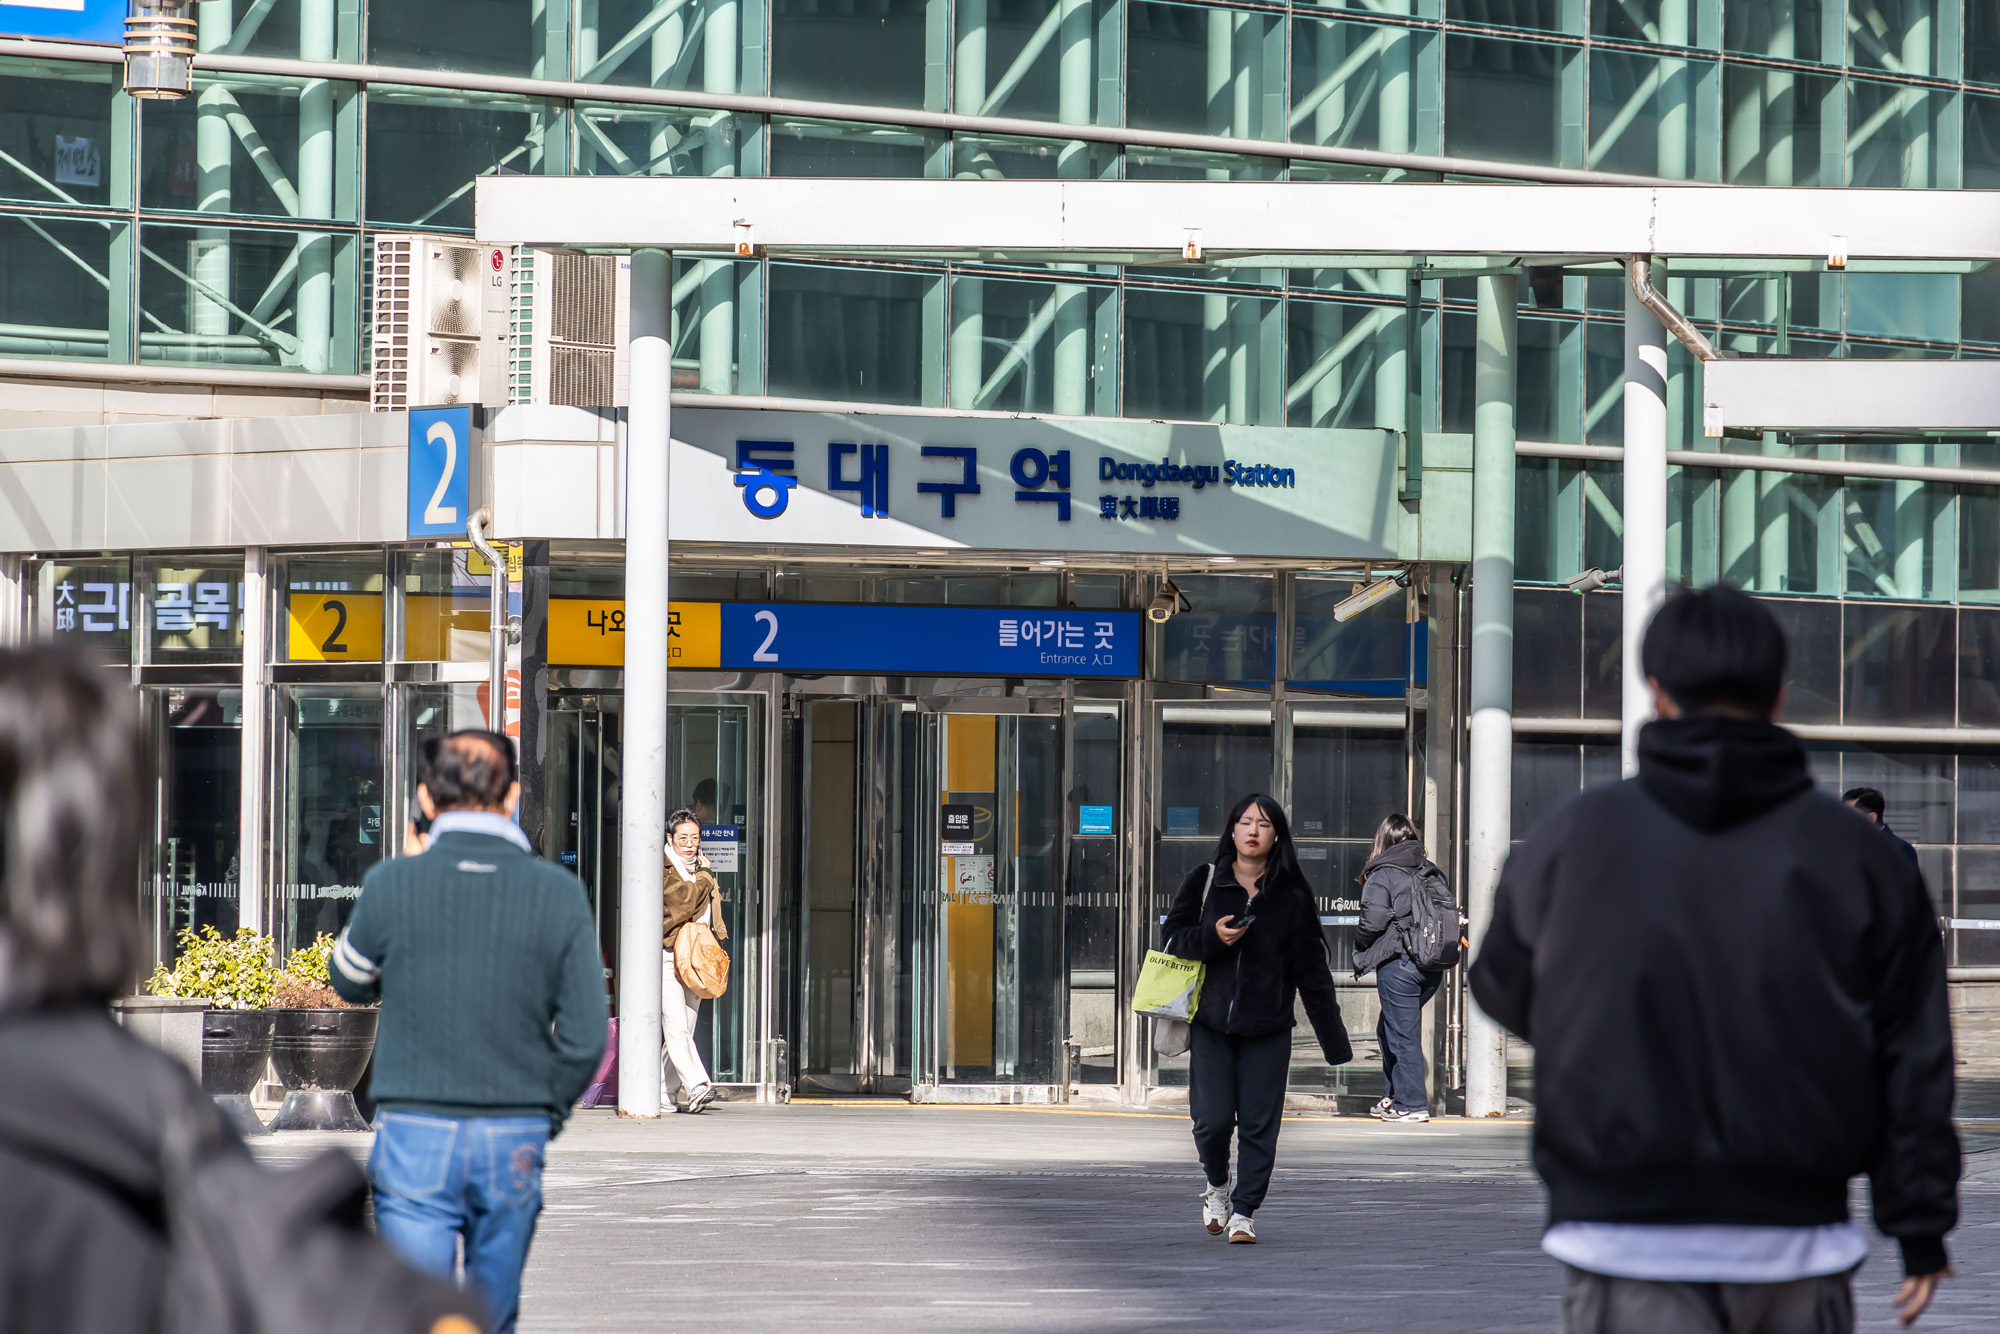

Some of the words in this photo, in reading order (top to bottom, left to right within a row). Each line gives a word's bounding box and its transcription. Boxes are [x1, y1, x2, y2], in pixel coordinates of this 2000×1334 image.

[491, 276, 503, 287] LG
[424, 421, 457, 525] 2
[733, 440, 1072, 521] 동대구역
[1099, 457, 1219, 489] Dongdaegu
[1223, 460, 1295, 488] Station
[322, 600, 347, 653] 2
[587, 609, 625, 635] 나오
[999, 620, 1085, 648] 들어가는
[1094, 622, 1114, 649] 곳
[753, 610, 779, 662] 2
[1040, 651, 1087, 665] Entrance
[968, 893, 1018, 905] KORAIL
[1331, 897, 1361, 912] KORAIL
[1149, 956, 1170, 967] OLIVE
[1170, 961, 1195, 972] BETTER
